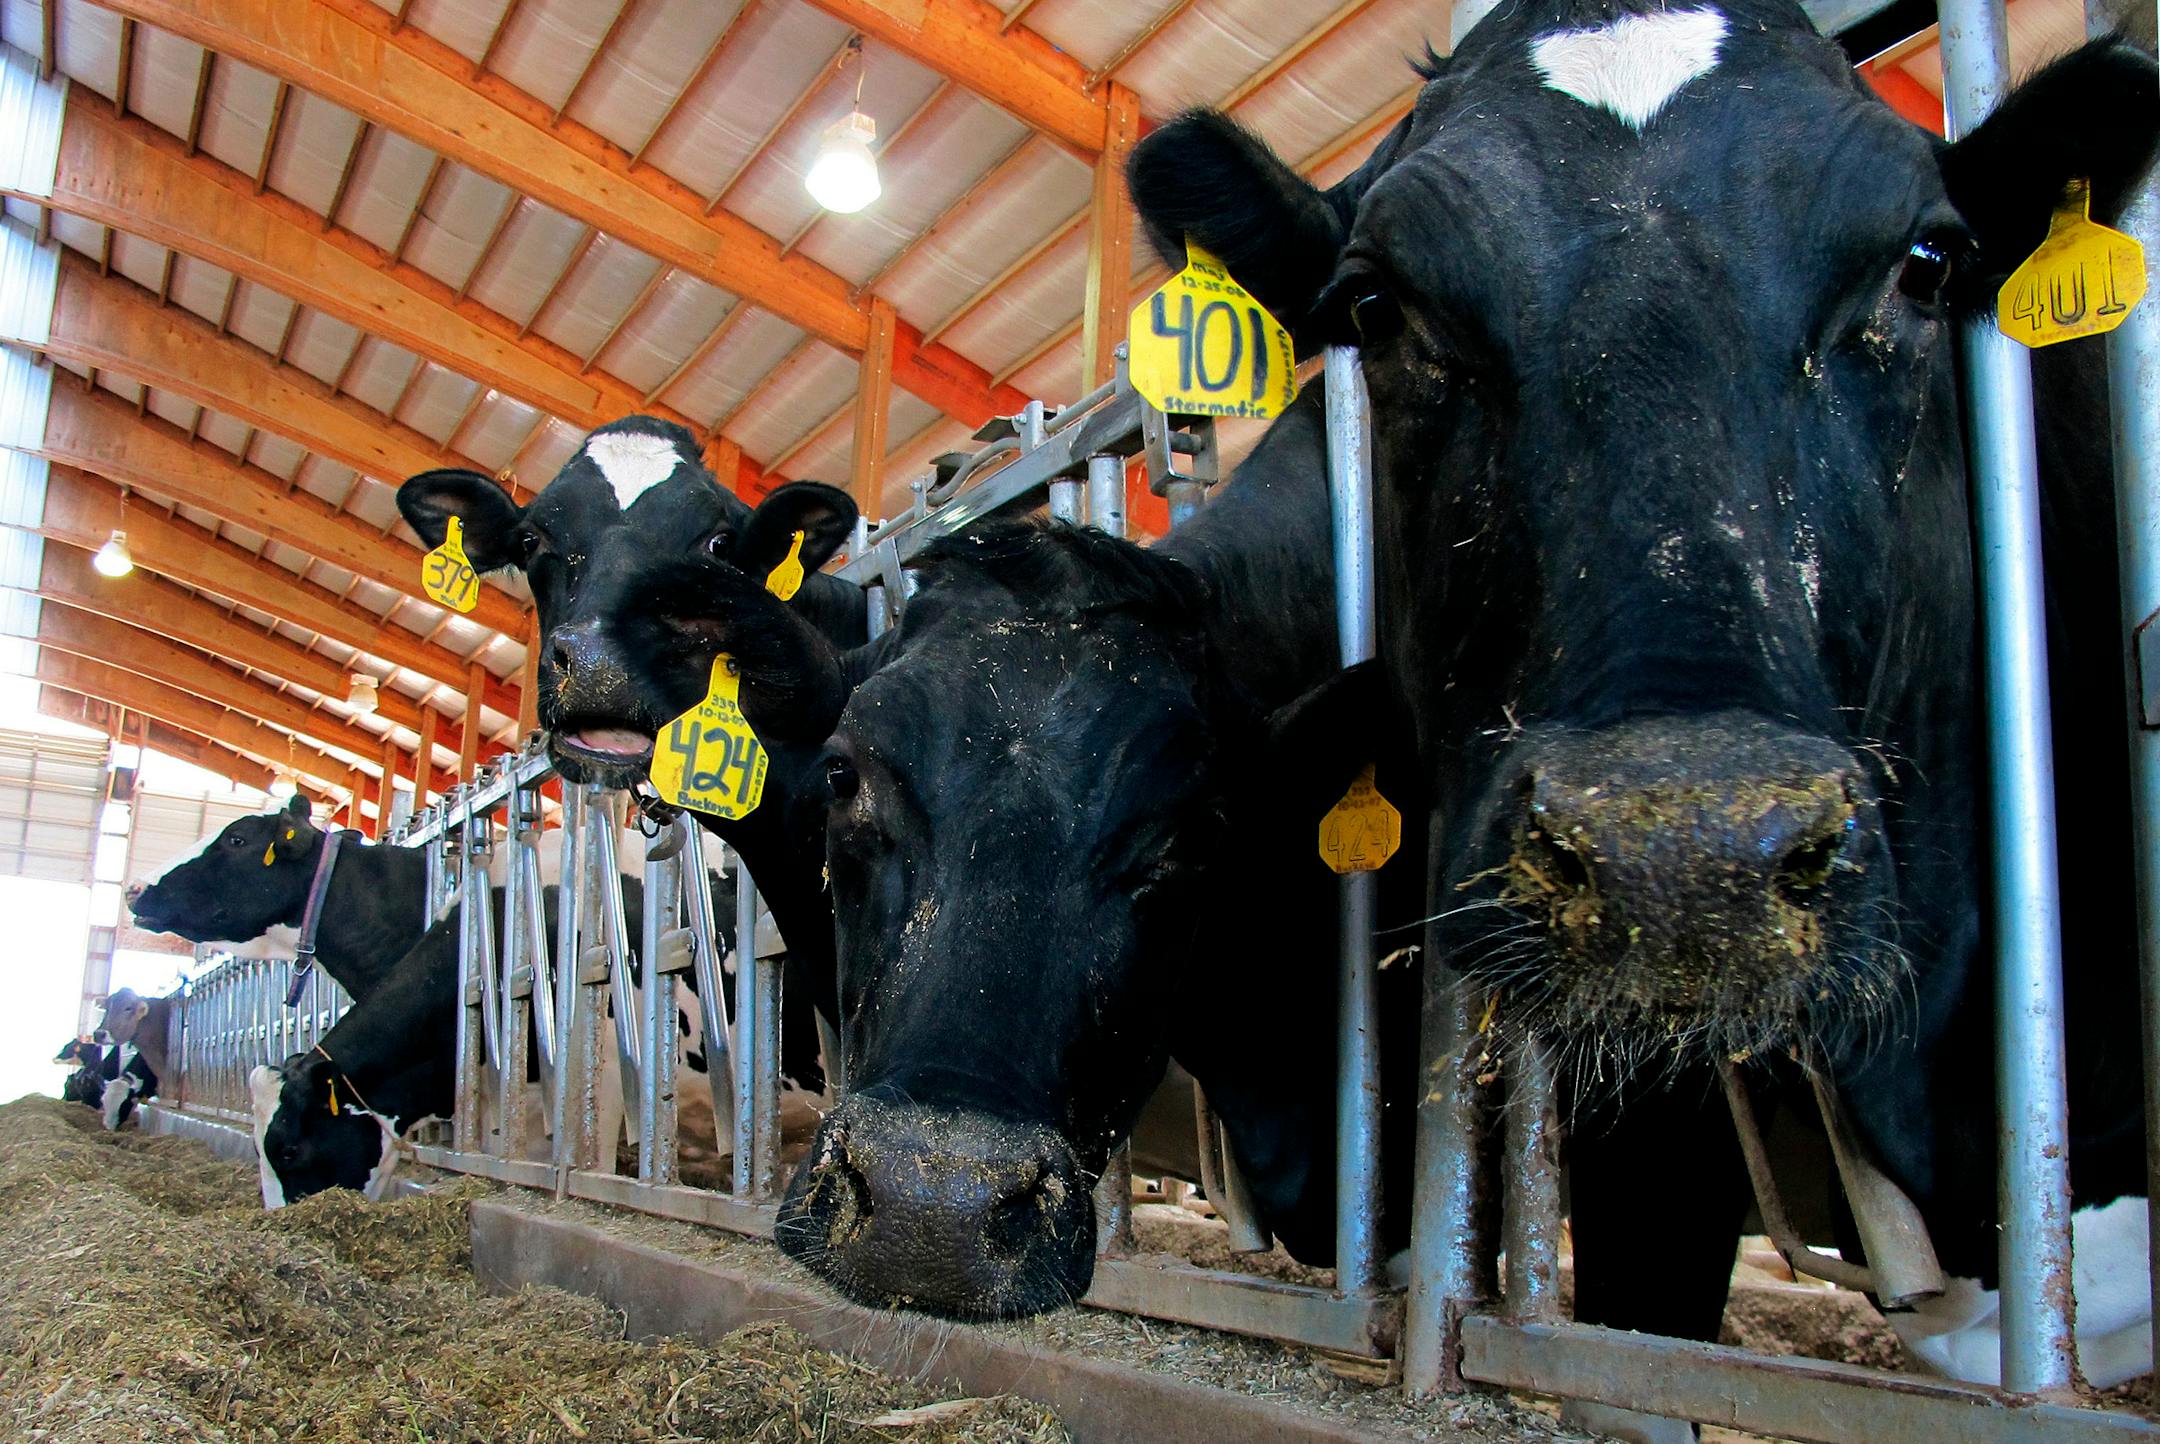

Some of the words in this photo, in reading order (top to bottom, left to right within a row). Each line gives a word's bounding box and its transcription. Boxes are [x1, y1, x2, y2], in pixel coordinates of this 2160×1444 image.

[1151, 291, 1268, 400] 401
[427, 550, 474, 602] 379
[670, 719, 760, 805] 424
[677, 791, 737, 819] Buckeye
[1327, 808, 1391, 864] 424
